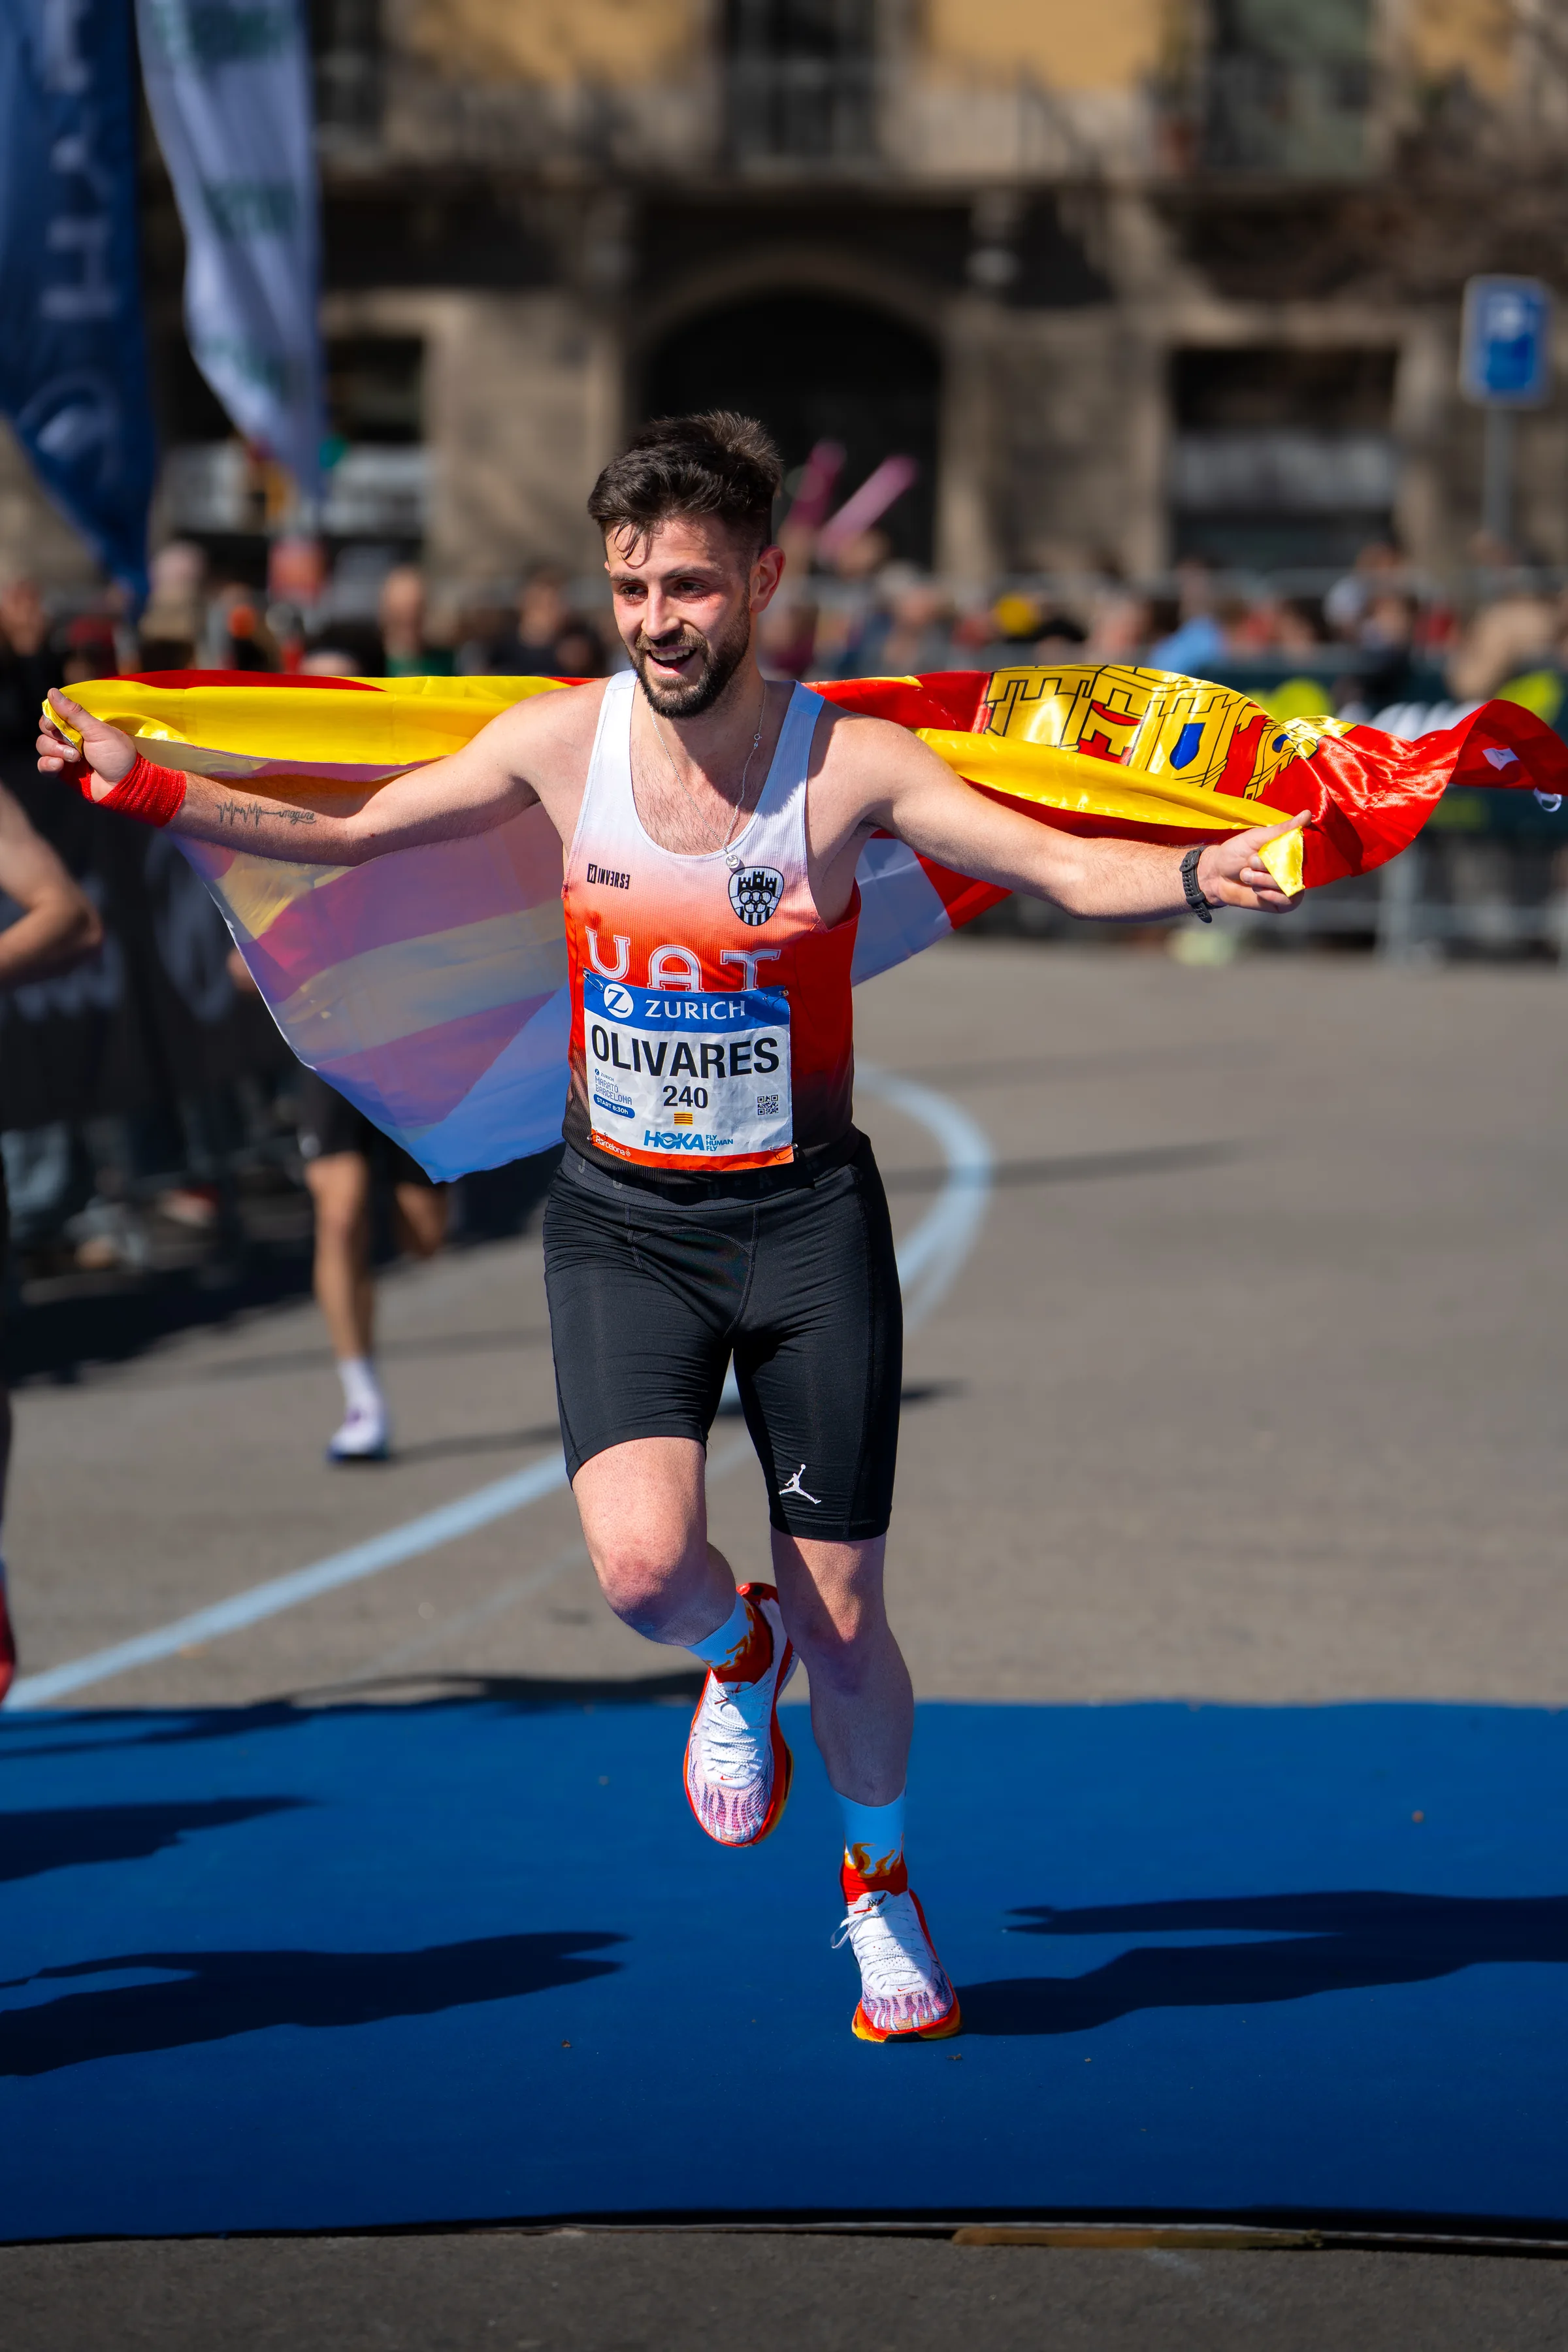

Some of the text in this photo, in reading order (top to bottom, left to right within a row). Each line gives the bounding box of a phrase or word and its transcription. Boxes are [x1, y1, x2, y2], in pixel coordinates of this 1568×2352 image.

[585, 926, 781, 992] UAT
[644, 999, 746, 1020] ZURICH
[591, 1024, 779, 1079] OLIVARES
[600, 1072, 614, 1081] ZURICH
[595, 1085, 632, 1105] BARCELONA
[662, 1085, 708, 1109] 240
[596, 1097, 629, 1115] START 8:30h
[595, 1135, 625, 1156] Barcelona
[644, 1130, 705, 1151] HOKA
